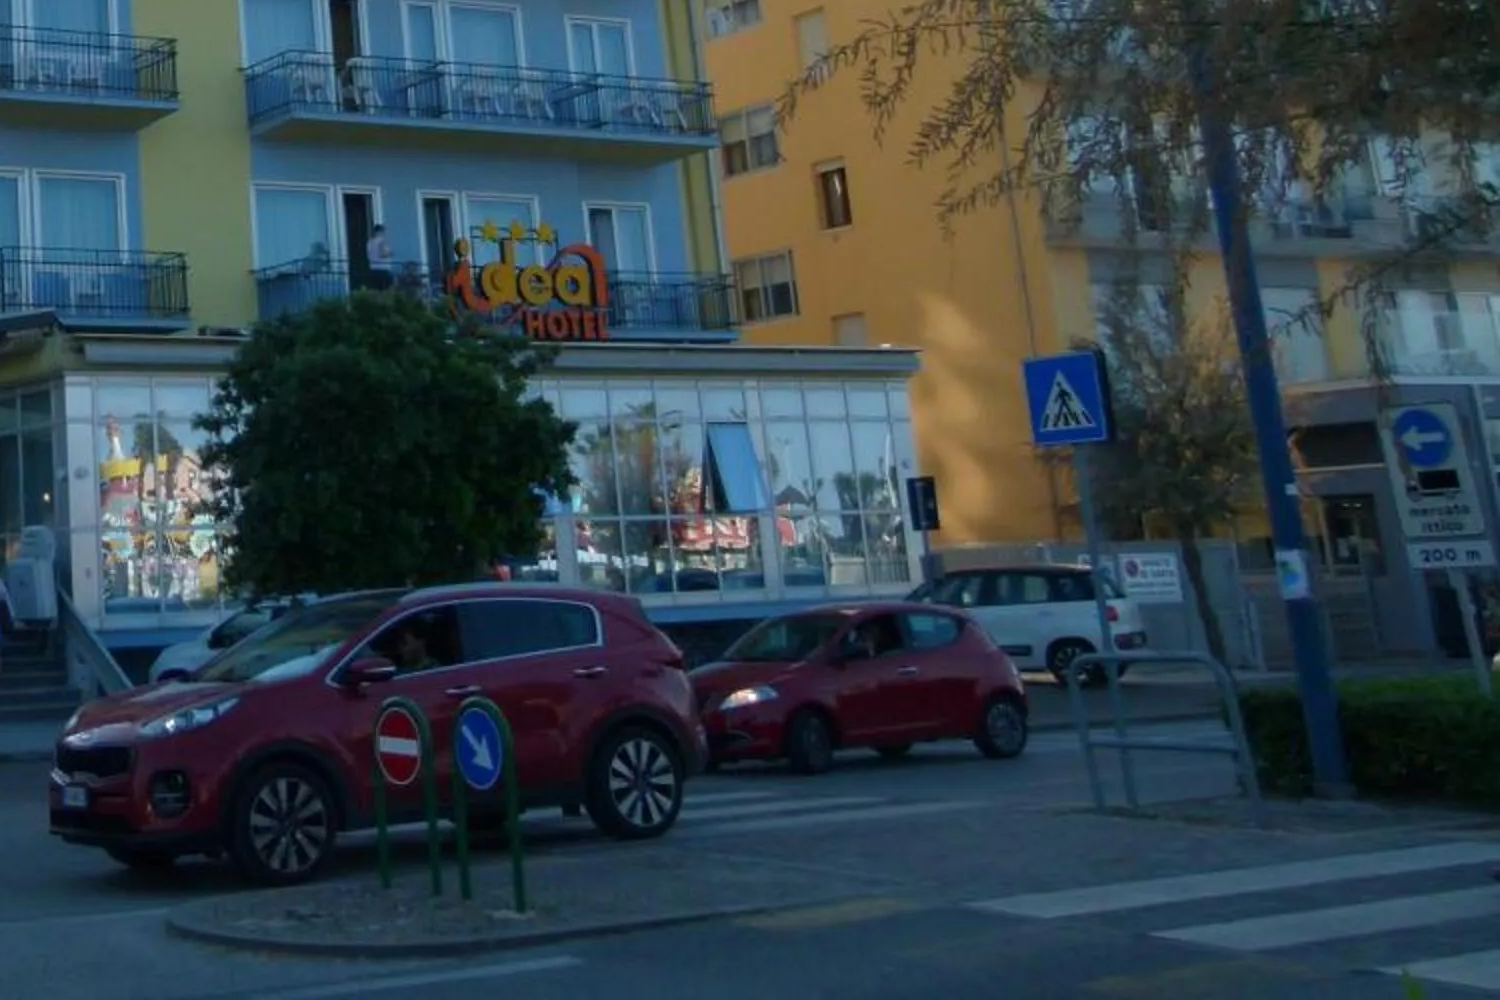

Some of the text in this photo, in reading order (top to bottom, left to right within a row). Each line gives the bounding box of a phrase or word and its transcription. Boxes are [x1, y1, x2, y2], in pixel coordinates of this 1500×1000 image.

[524, 311, 610, 340] HOTEL
[1409, 504, 1470, 516] mercato
[1419, 549, 1481, 562] 200 m
